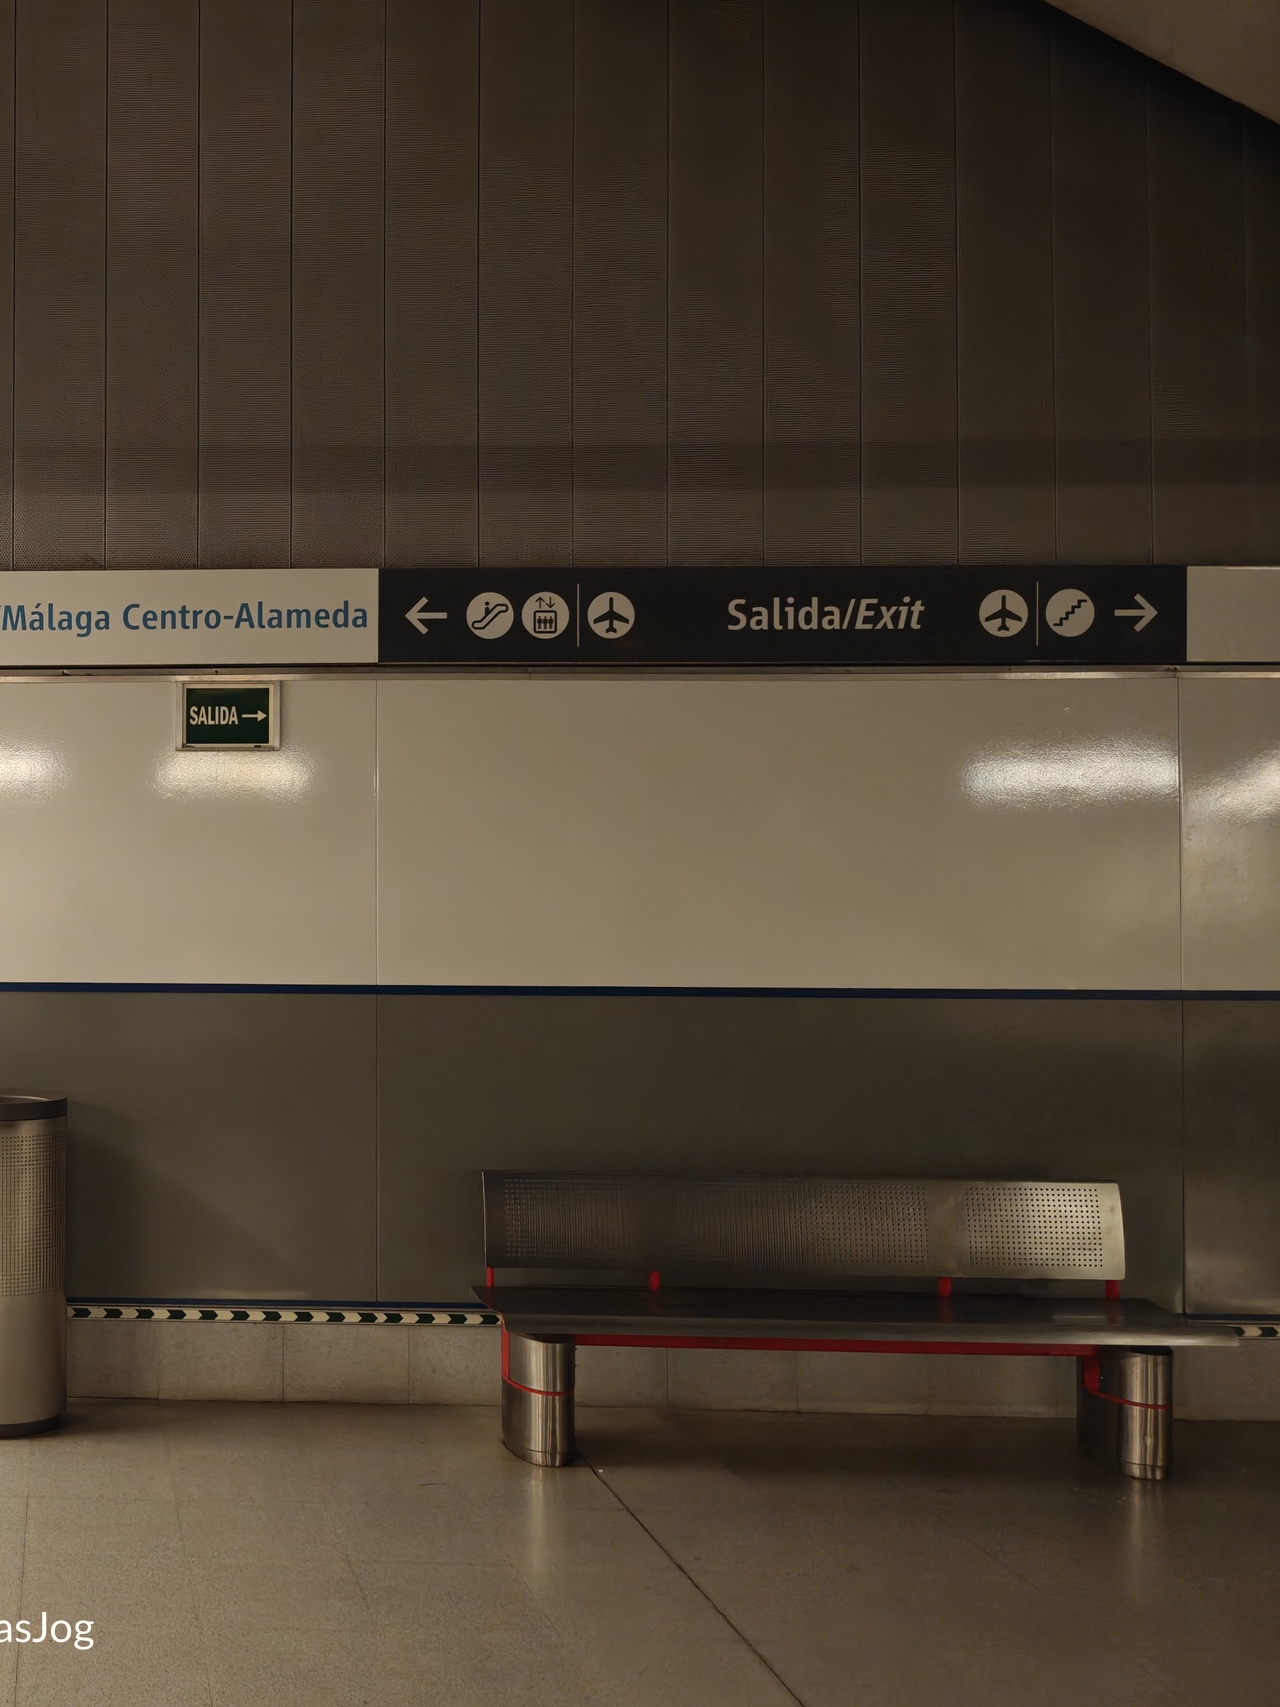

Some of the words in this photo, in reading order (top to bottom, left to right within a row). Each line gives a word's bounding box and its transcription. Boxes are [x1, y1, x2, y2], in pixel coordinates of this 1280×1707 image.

[122, 600, 369, 631] Centro-Alameda
[727, 596, 926, 631] Salida/Exit
[189, 705, 239, 726] SALIDA
